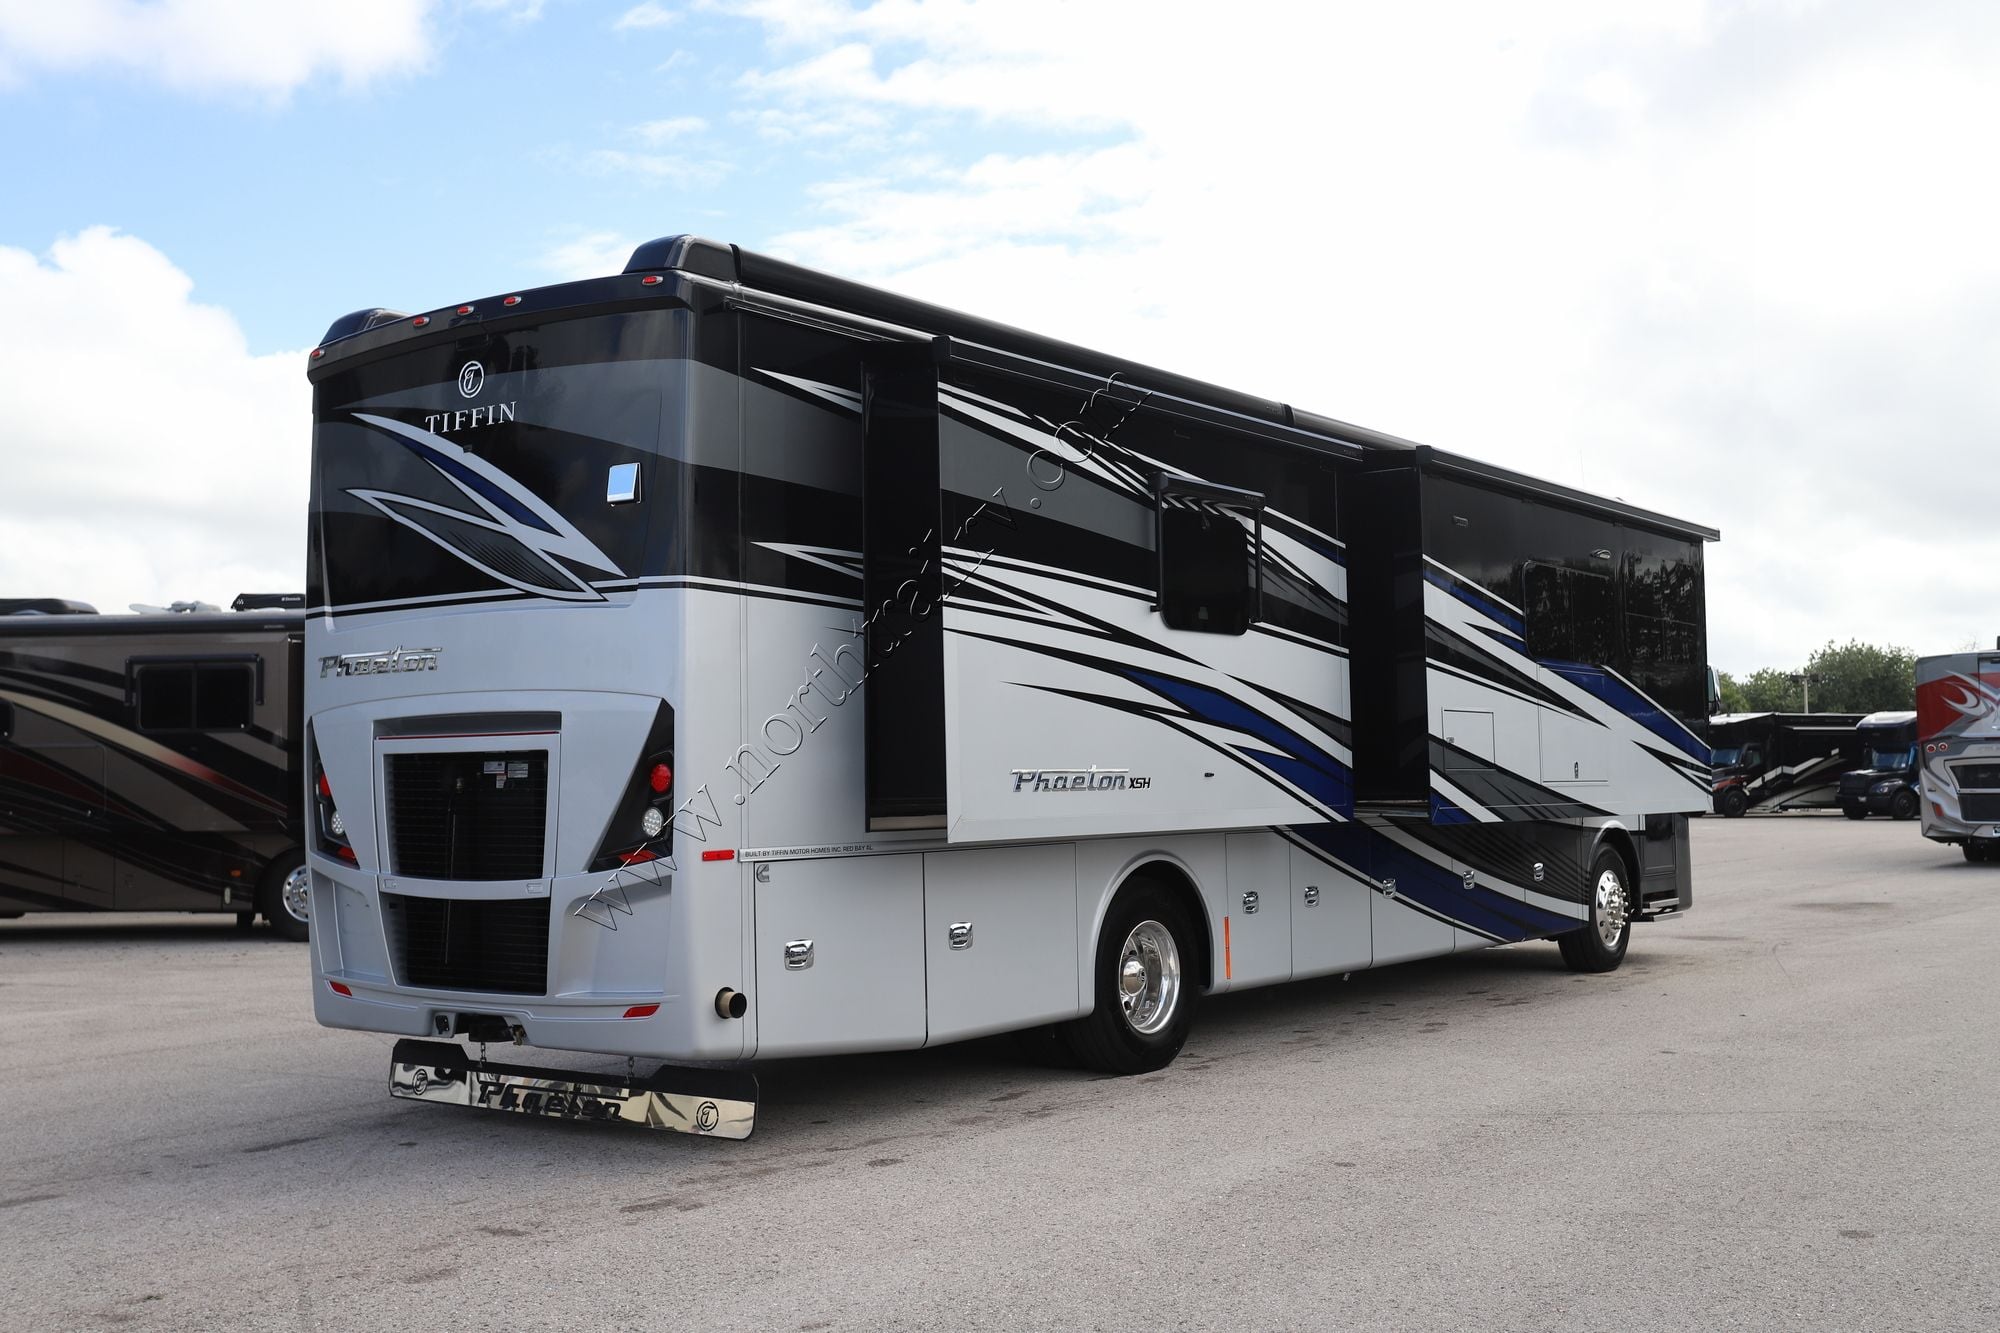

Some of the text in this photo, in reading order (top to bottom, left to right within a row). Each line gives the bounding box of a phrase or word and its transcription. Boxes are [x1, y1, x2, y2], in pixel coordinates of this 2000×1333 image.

[424, 400, 517, 435] TIFFIN
[318, 645, 443, 679] Phaeton
[1010, 764, 1129, 793] Phaeton
[745, 850, 761, 858] BUILT
[772, 848, 789, 857] TIFFIN
[789, 847, 810, 856] MOTOR
[810, 846, 831, 855] HOMES
[843, 844, 854, 853] RED
[855, 844, 866, 852] BAY
